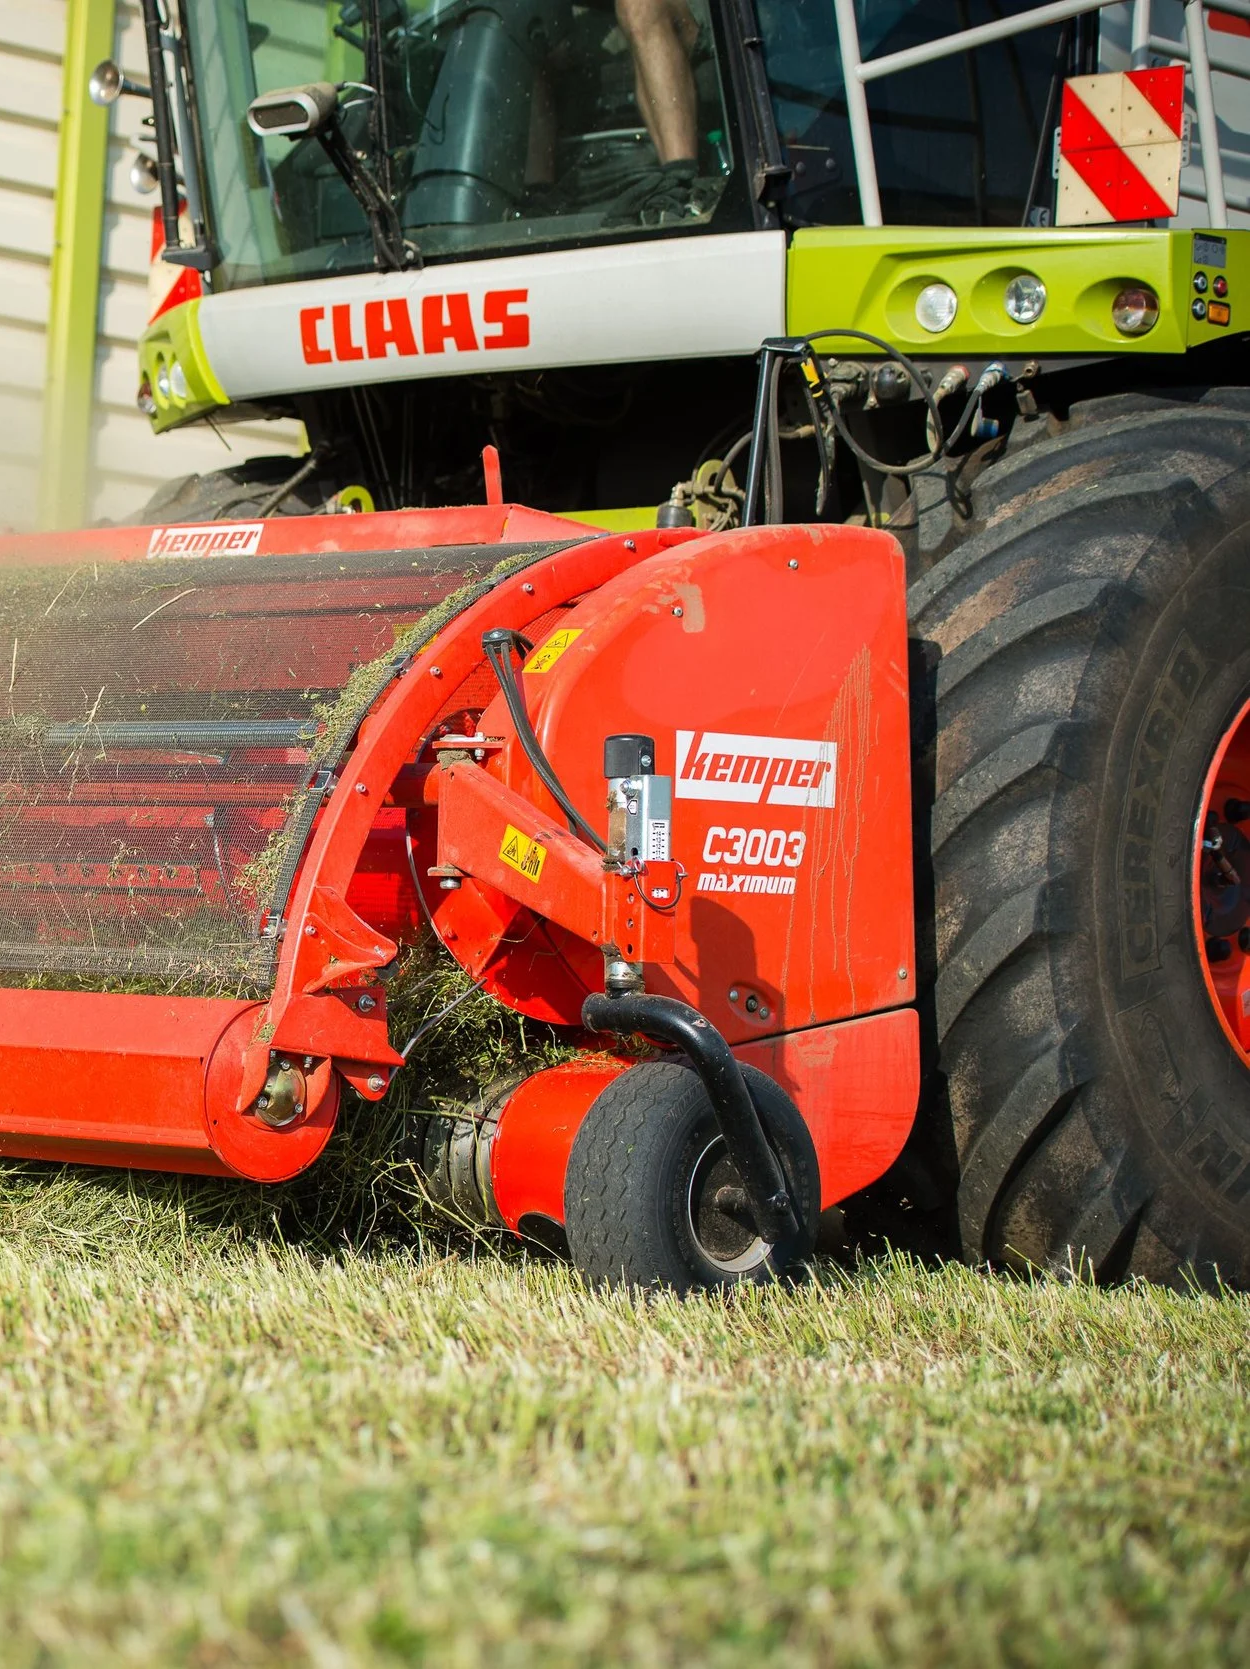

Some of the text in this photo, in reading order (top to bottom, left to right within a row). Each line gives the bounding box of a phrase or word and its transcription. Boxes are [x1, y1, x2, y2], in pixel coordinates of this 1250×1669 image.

[299, 288, 531, 365] CLAAS
[150, 528, 259, 557] kemper
[679, 731, 831, 805] kemper
[702, 826, 806, 867] C3003
